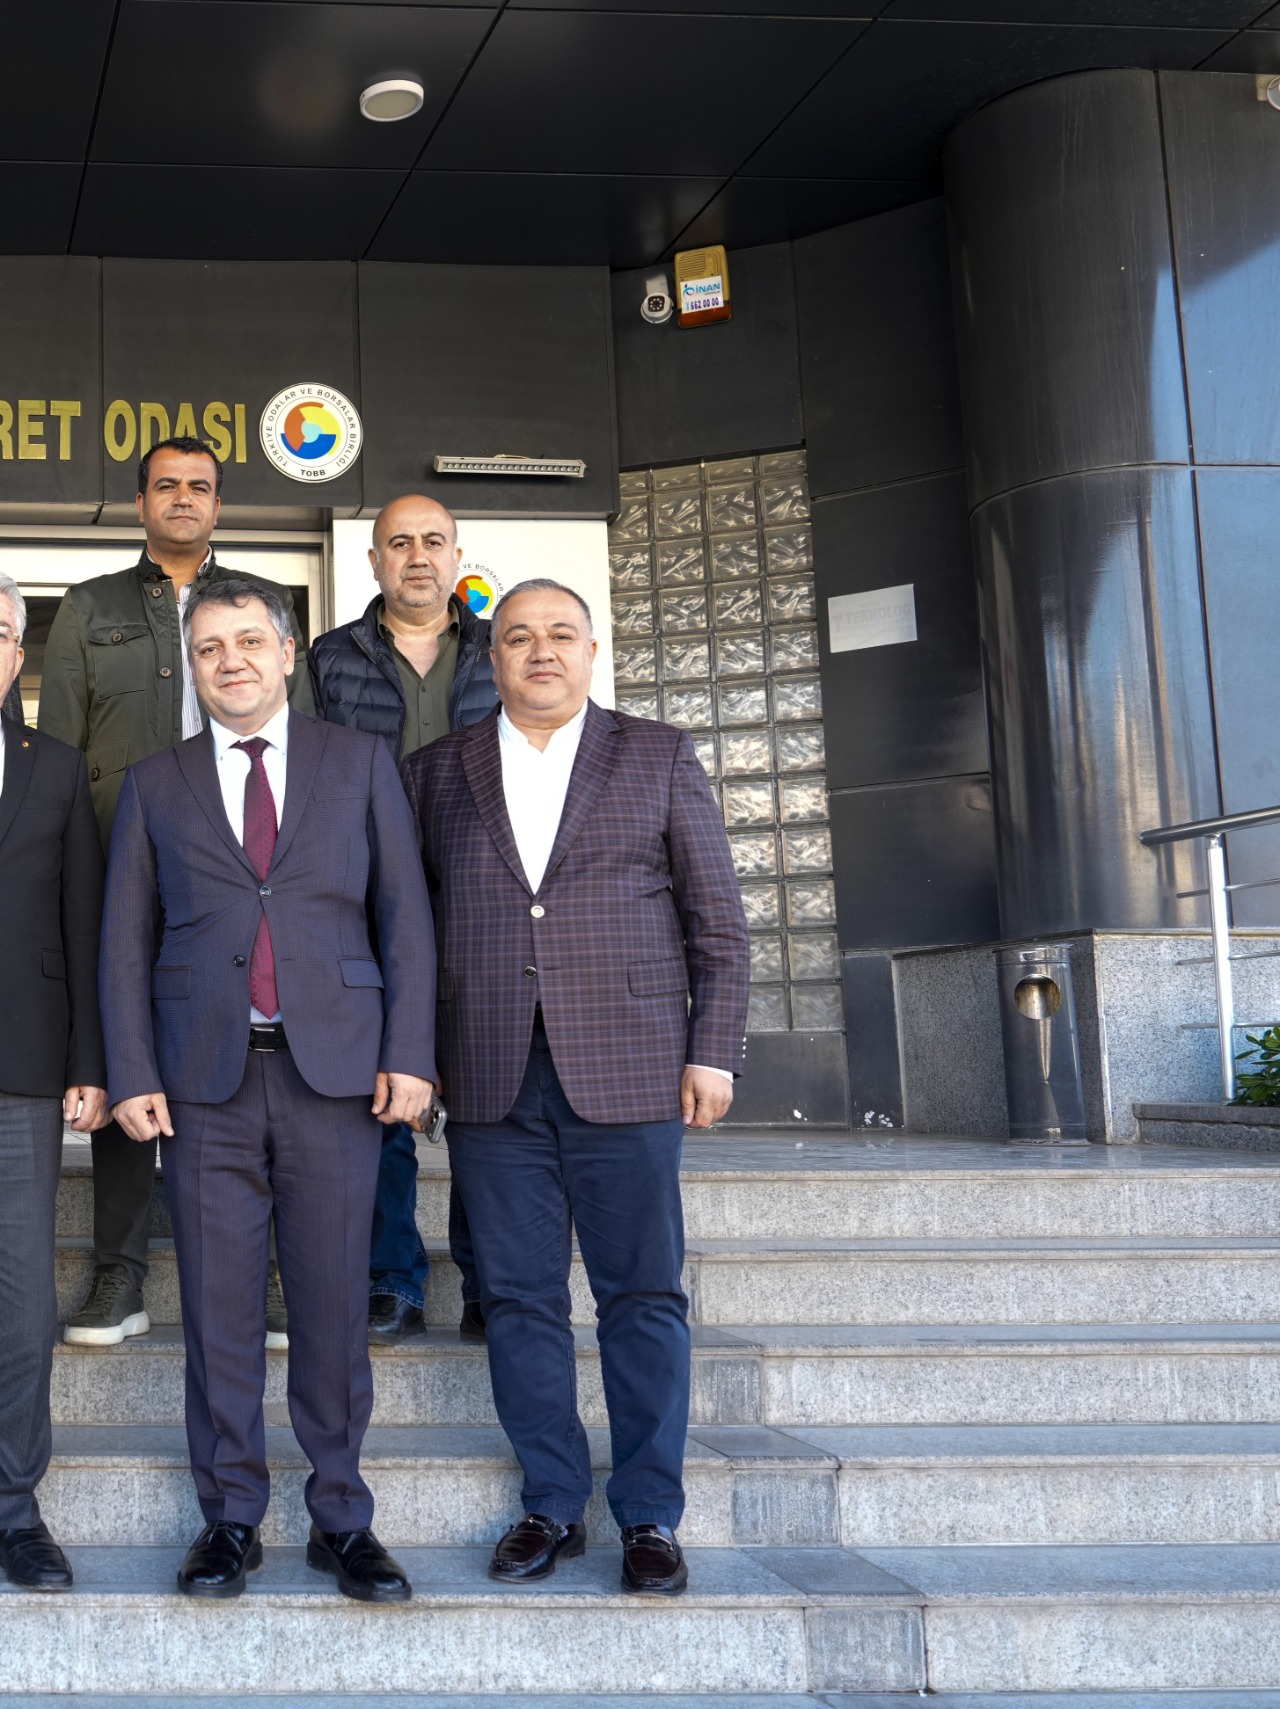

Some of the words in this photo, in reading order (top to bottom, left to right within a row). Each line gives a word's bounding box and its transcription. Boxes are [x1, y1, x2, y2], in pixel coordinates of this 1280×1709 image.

[691, 300, 701, 310] 662
[703, 299, 710, 308] 00
[268, 391, 297, 422] ODALAR
[317, 388, 356, 430] BORSALAR
[103, 399, 247, 463] ODASI
[266, 426, 288, 468] TÜRKİYE
[300, 469, 327, 477] TOBB
